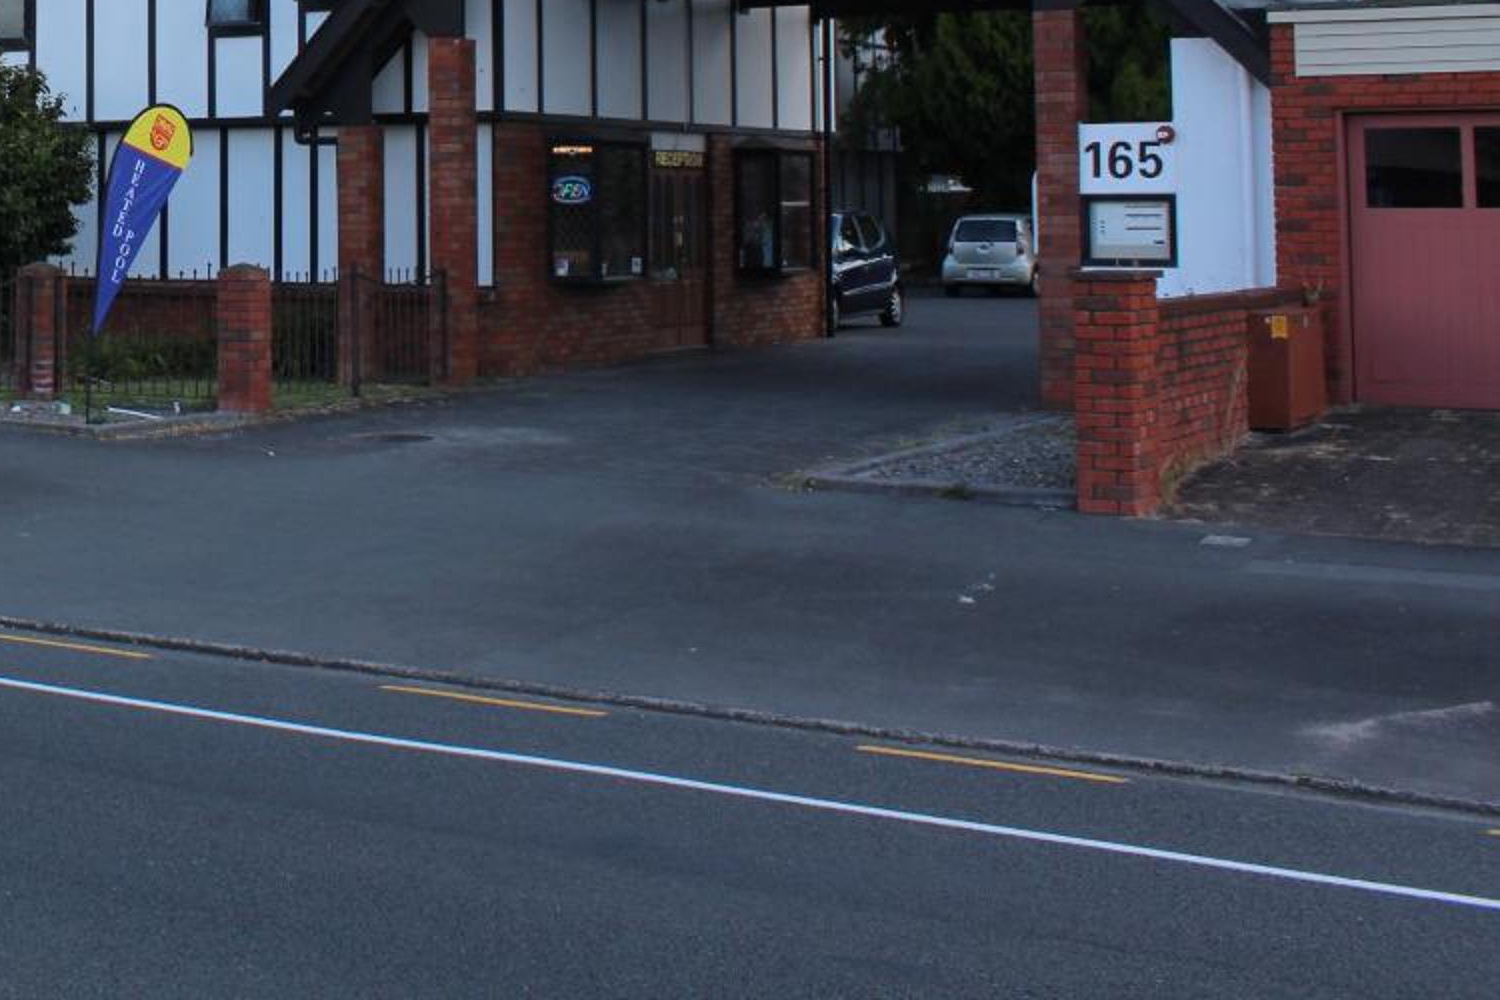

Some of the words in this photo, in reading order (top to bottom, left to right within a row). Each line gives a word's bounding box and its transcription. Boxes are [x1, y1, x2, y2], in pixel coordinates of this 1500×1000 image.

[1084, 140, 1162, 179] 165
[112, 159, 145, 238] HEATED
[111, 230, 134, 284] POOL
